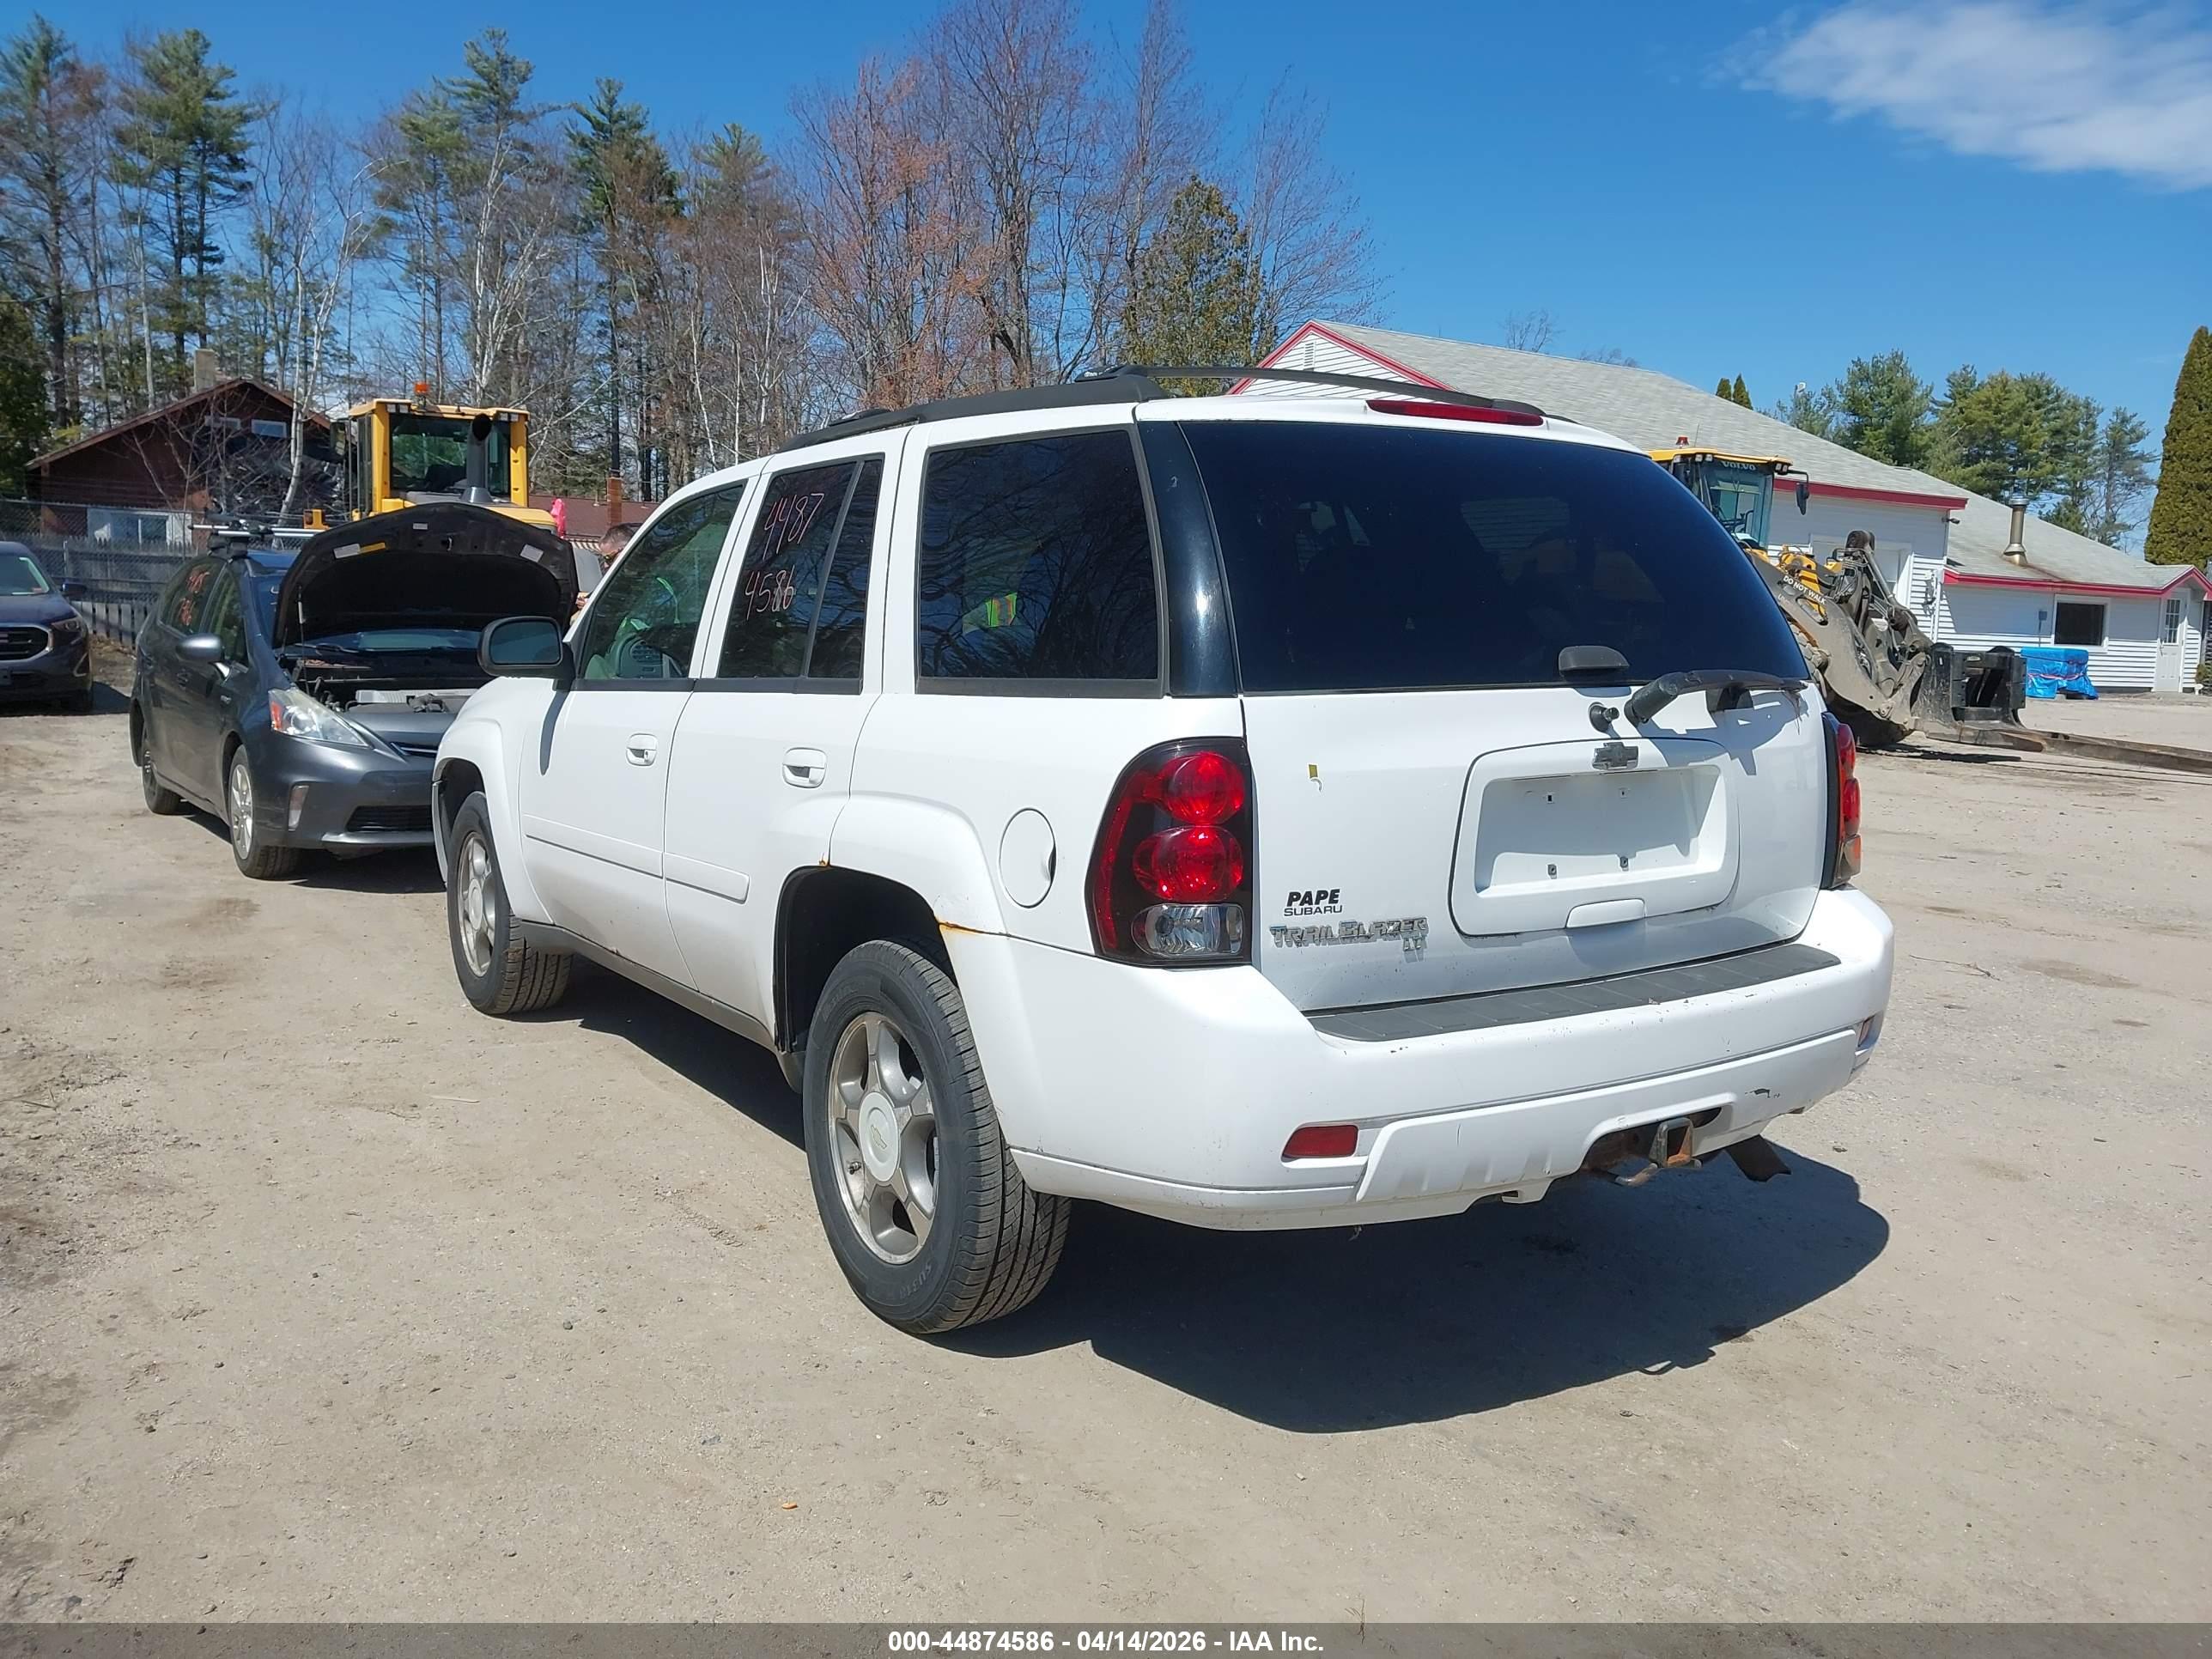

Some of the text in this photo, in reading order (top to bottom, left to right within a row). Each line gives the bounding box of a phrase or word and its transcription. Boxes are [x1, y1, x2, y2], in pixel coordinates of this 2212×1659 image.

[763, 493, 825, 561] 4487
[744, 564, 795, 620] 4586
[1783, 575, 1826, 605] DO NOT WALK
[1284, 905, 1343, 917] SUBARU
[1286, 889, 1340, 907] PAPE
